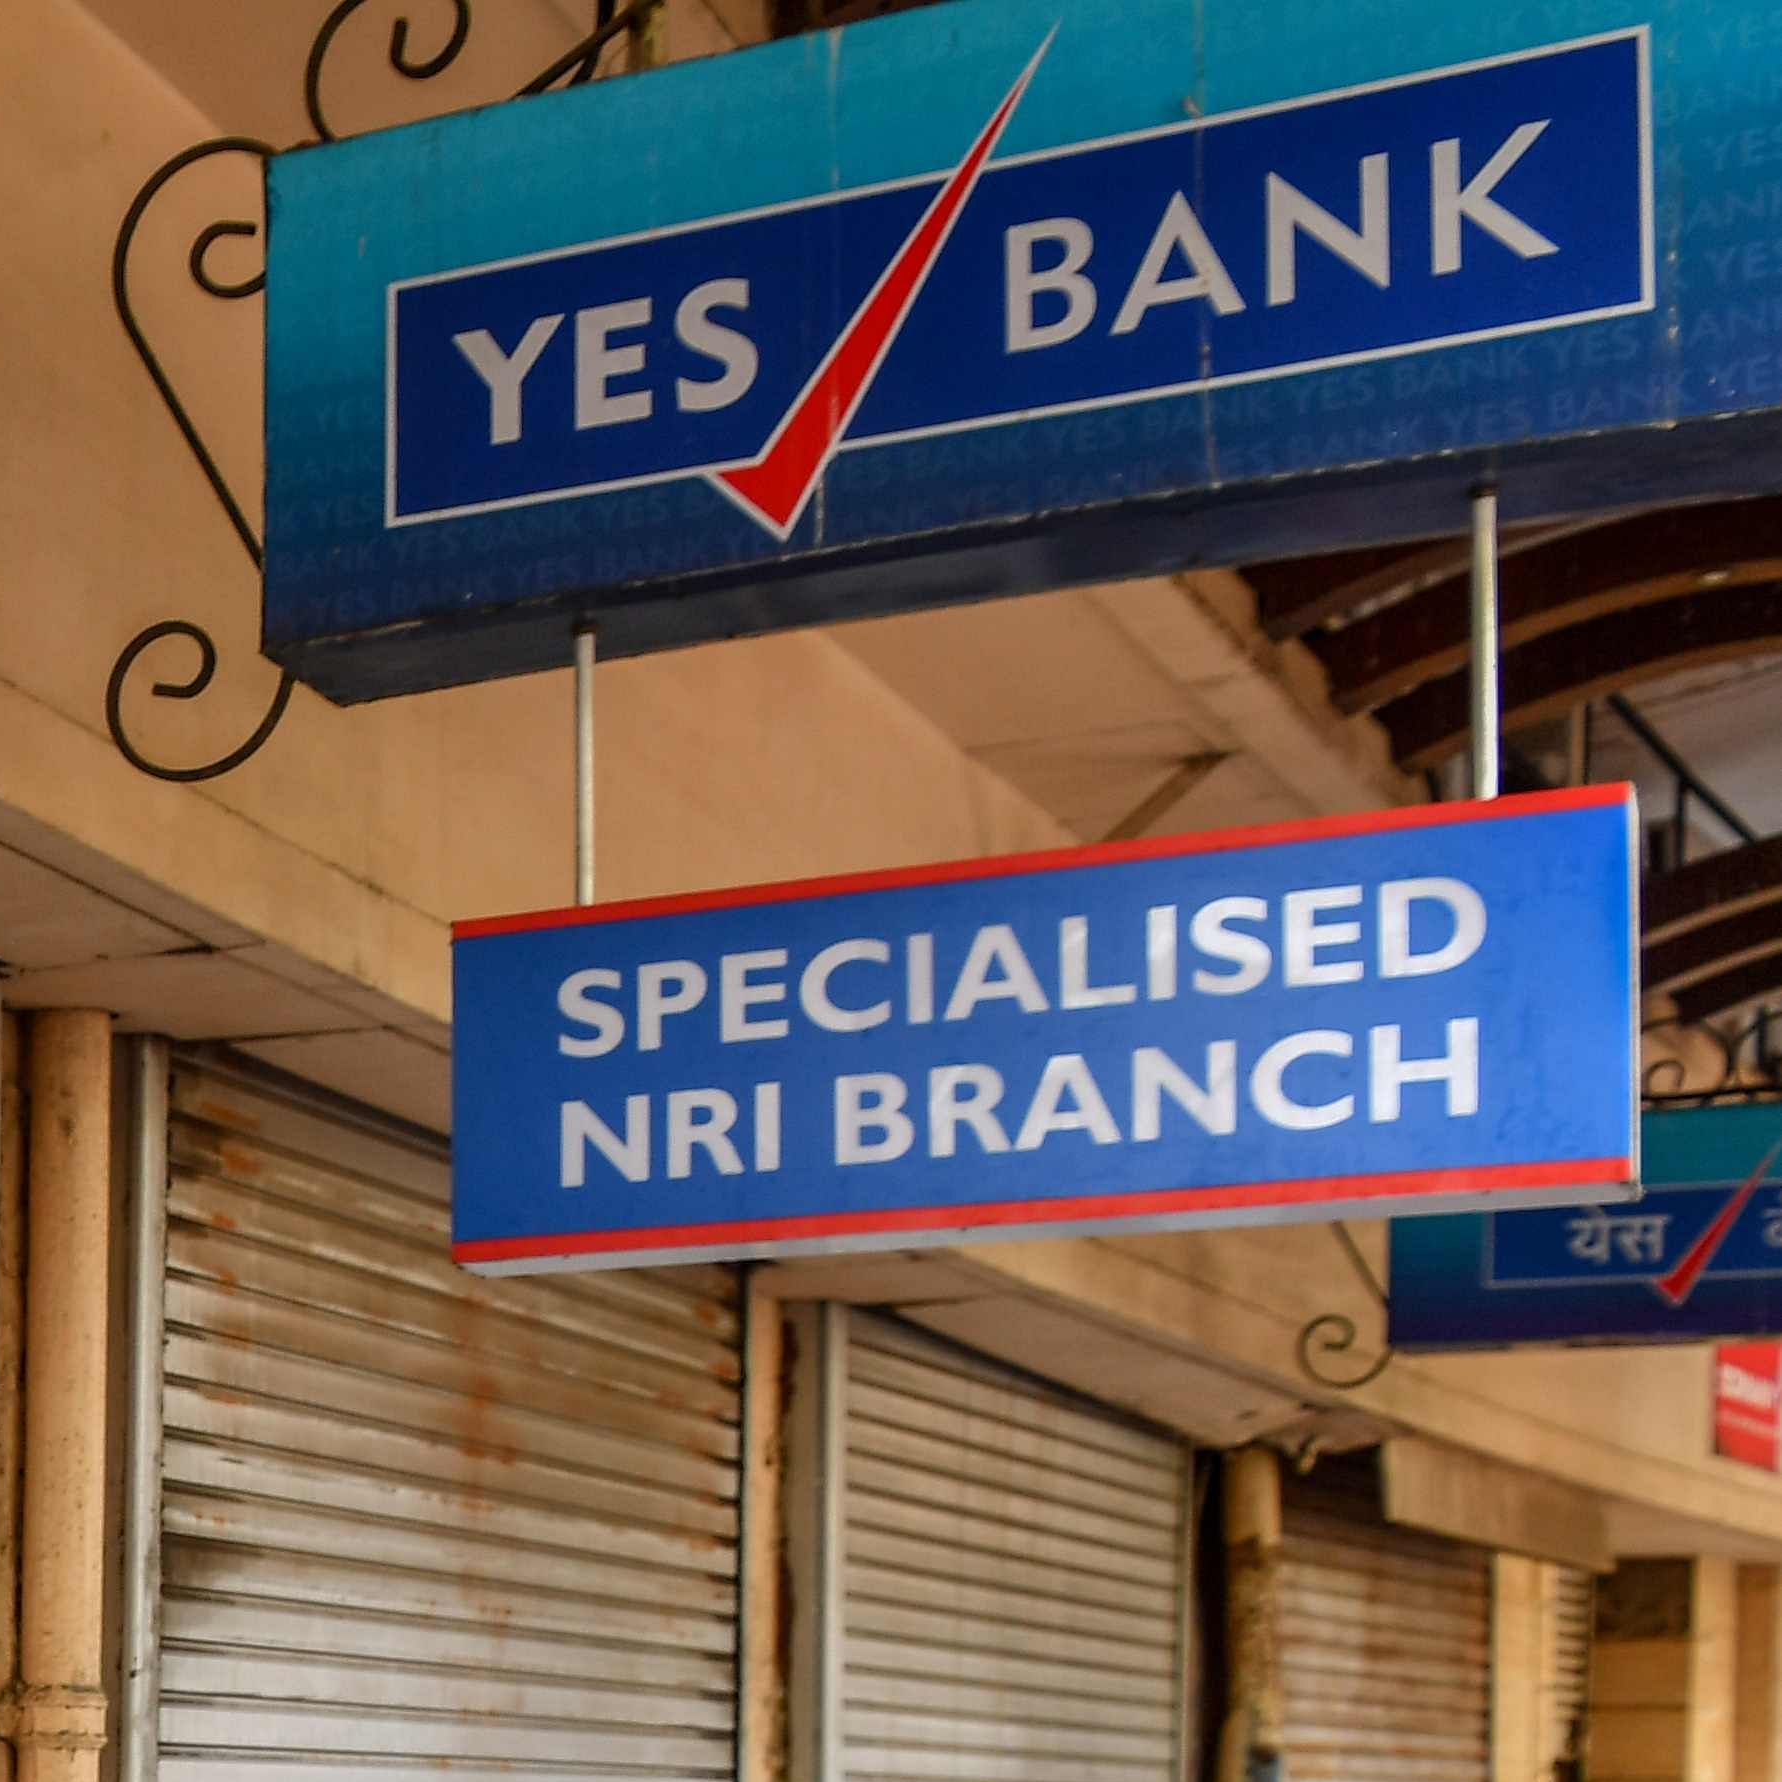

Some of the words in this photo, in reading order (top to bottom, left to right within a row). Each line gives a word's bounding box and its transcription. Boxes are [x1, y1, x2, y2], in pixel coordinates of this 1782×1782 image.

[451, 278, 758, 447] YES
[1005, 118, 1561, 355] BANK
[556, 877, 1486, 1060] SPECIALISED
[560, 1082, 780, 1188] NRI
[836, 1018, 1480, 1168] BRANCH
[1566, 1205, 1671, 1262] येस
